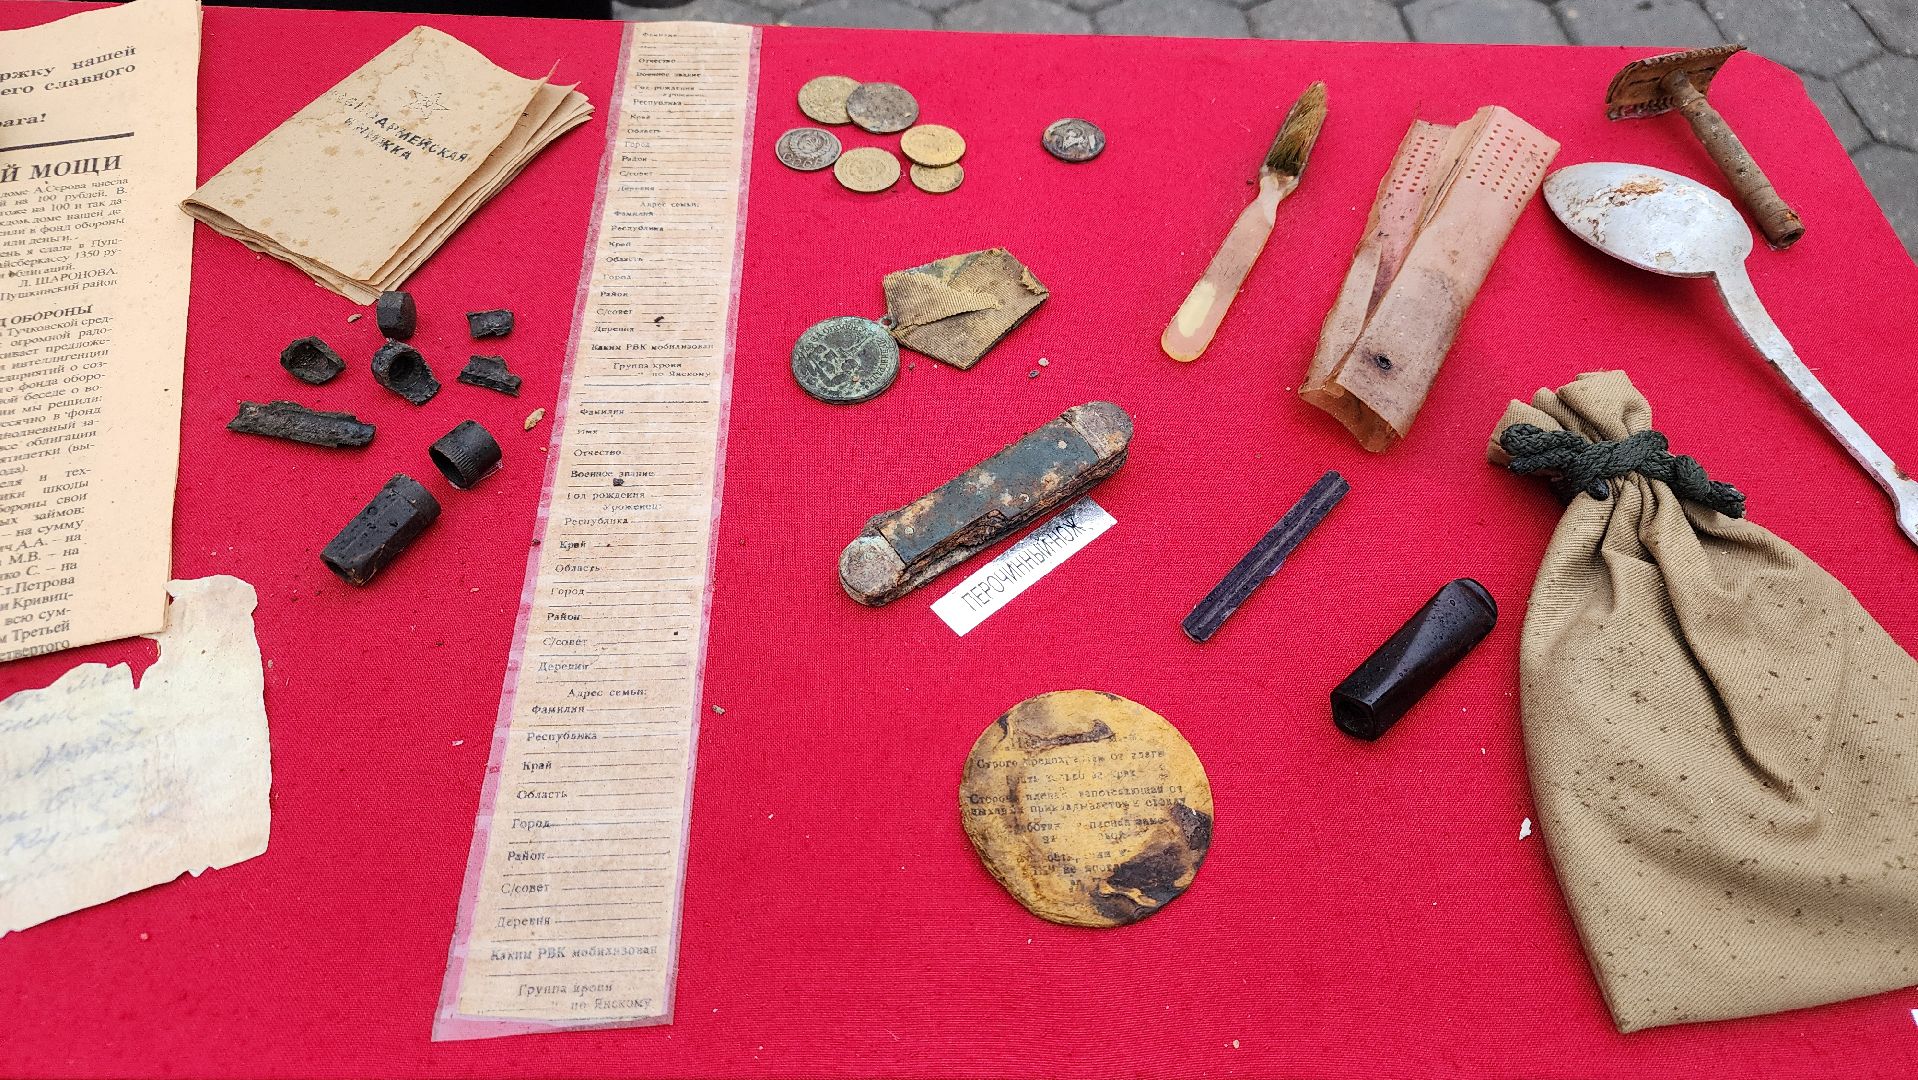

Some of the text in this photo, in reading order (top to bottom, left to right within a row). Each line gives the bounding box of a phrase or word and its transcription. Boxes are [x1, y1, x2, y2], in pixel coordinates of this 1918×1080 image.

[72, 46, 136, 70] нашей
[44, 65, 136, 90] славного
[331, 90, 469, 162] САРМЕЙСКАЯ
[28, 155, 123, 180] МОЩИ
[51, 202, 71, 212] 100
[75, 218, 125, 230] обороны
[75, 250, 100, 259] 1350
[35, 268, 118, 285] ШАРОНОВА.
[11, 304, 94, 325] ОБОРОНЫ
[596, 308, 633, 316] С/совет
[8, 319, 79, 337] Тучковской
[11, 331, 71, 347] огромной
[46, 339, 110, 353] предложе-
[591, 343, 714, 351] Каким РВК мобилизован
[12, 350, 109, 369] интеллигенции
[613, 362, 682, 371] Группа крови
[48, 395, 103, 411] решили:
[573, 449, 622, 457] Отчество
[65, 468, 92, 477] тех-
[570, 470, 614, 478] Военное
[43, 480, 89, 494] школы
[57, 493, 88, 505] свои
[592, 492, 646, 500] рождения
[34, 507, 85, 521] займов:
[564, 517, 629, 526] Республика
[16, 520, 84, 537] на сумму
[65, 534, 81, 543] на
[559, 541, 586, 551] Край
[8, 548, 79, 565] М.В. на
[26, 562, 77, 576] С. на
[555, 564, 601, 573] Область
[961, 516, 1084, 611] ПЕРОЧИННЫЙ НОЖ
[550, 588, 585, 597] Город
[13, 592, 73, 610] Кривиц-
[5, 608, 71, 626] всю сум-
[547, 612, 581, 621] Район
[11, 620, 70, 643] Третьей
[542, 636, 588, 648] С/совет
[538, 662, 590, 673] Деревня
[567, 689, 647, 699] Адрес семьи:
[532, 705, 585, 714] Фамилия
[527, 732, 597, 744] Республика
[522, 761, 552, 773] Край
[976, 758, 1018, 769] Строго
[517, 790, 567, 799] Область
[512, 818, 551, 831] Город
[507, 851, 545, 861] Район
[501, 883, 550, 896] С/совет
[497, 916, 551, 929] Деревня
[491, 946, 657, 961] Каким РВК мобилизован
[517, 983, 613, 997] Группа крови
[570, 998, 652, 1011] по Янскому
